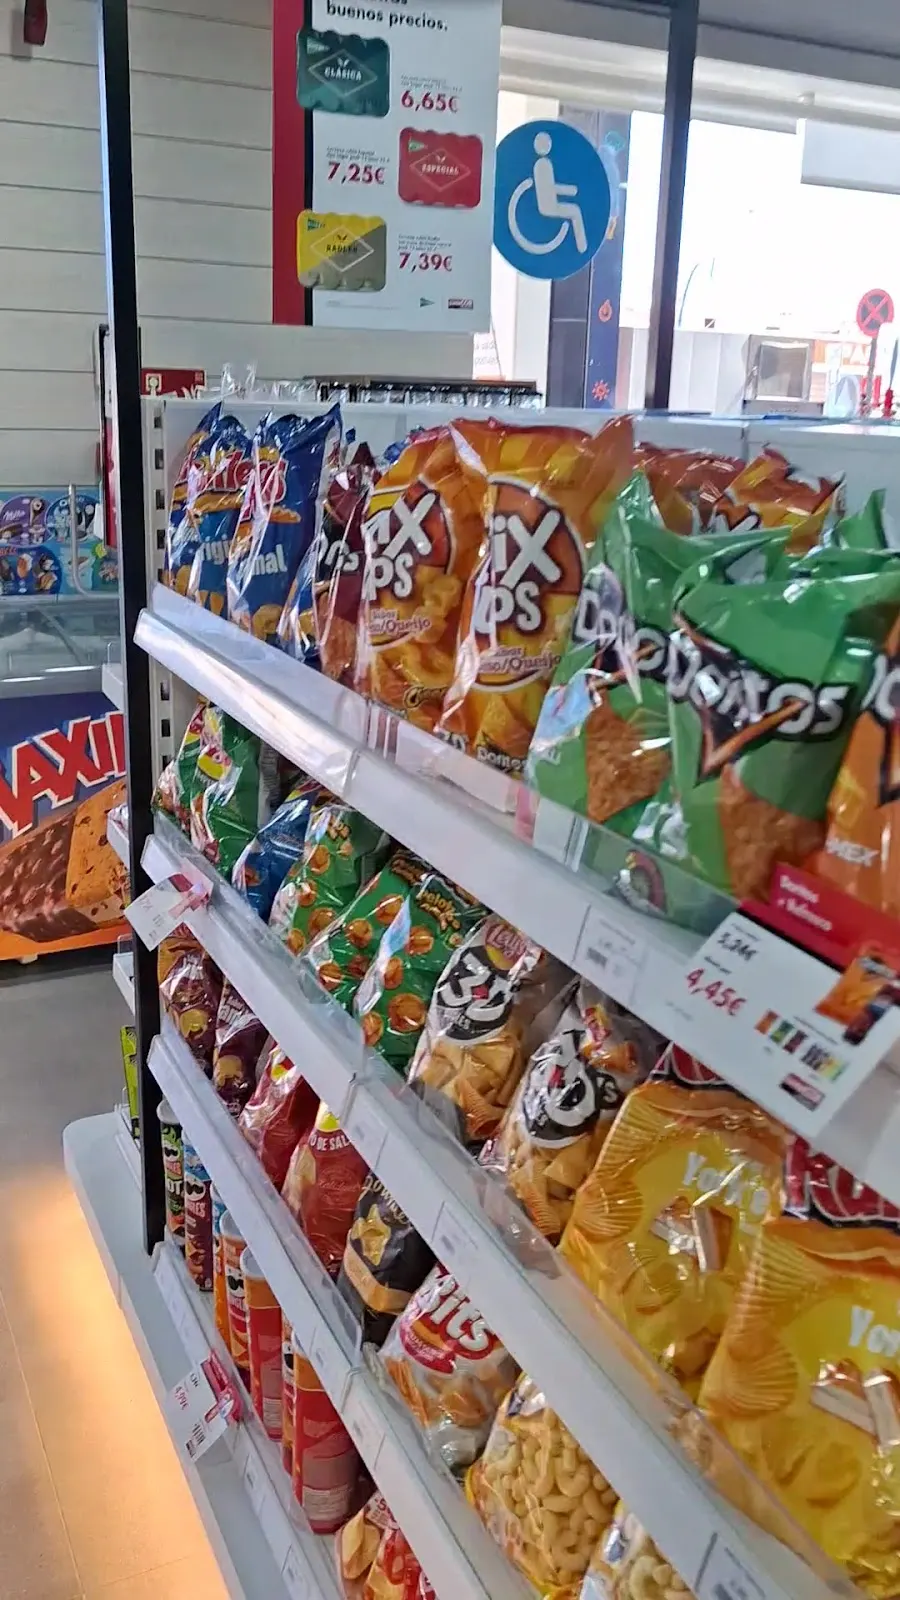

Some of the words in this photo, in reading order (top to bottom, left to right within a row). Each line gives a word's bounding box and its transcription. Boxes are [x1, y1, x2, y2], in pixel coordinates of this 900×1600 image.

[327, 0, 383, 21] buenos
[389, 12, 448, 31] precios.
[400, 90, 459, 113] 6,65€
[327, 160, 385, 185] 7,25€
[398, 252, 453, 273] 7,39€
[686, 967, 748, 1017] 4,45€
[329, 1134, 351, 1151] SAL
